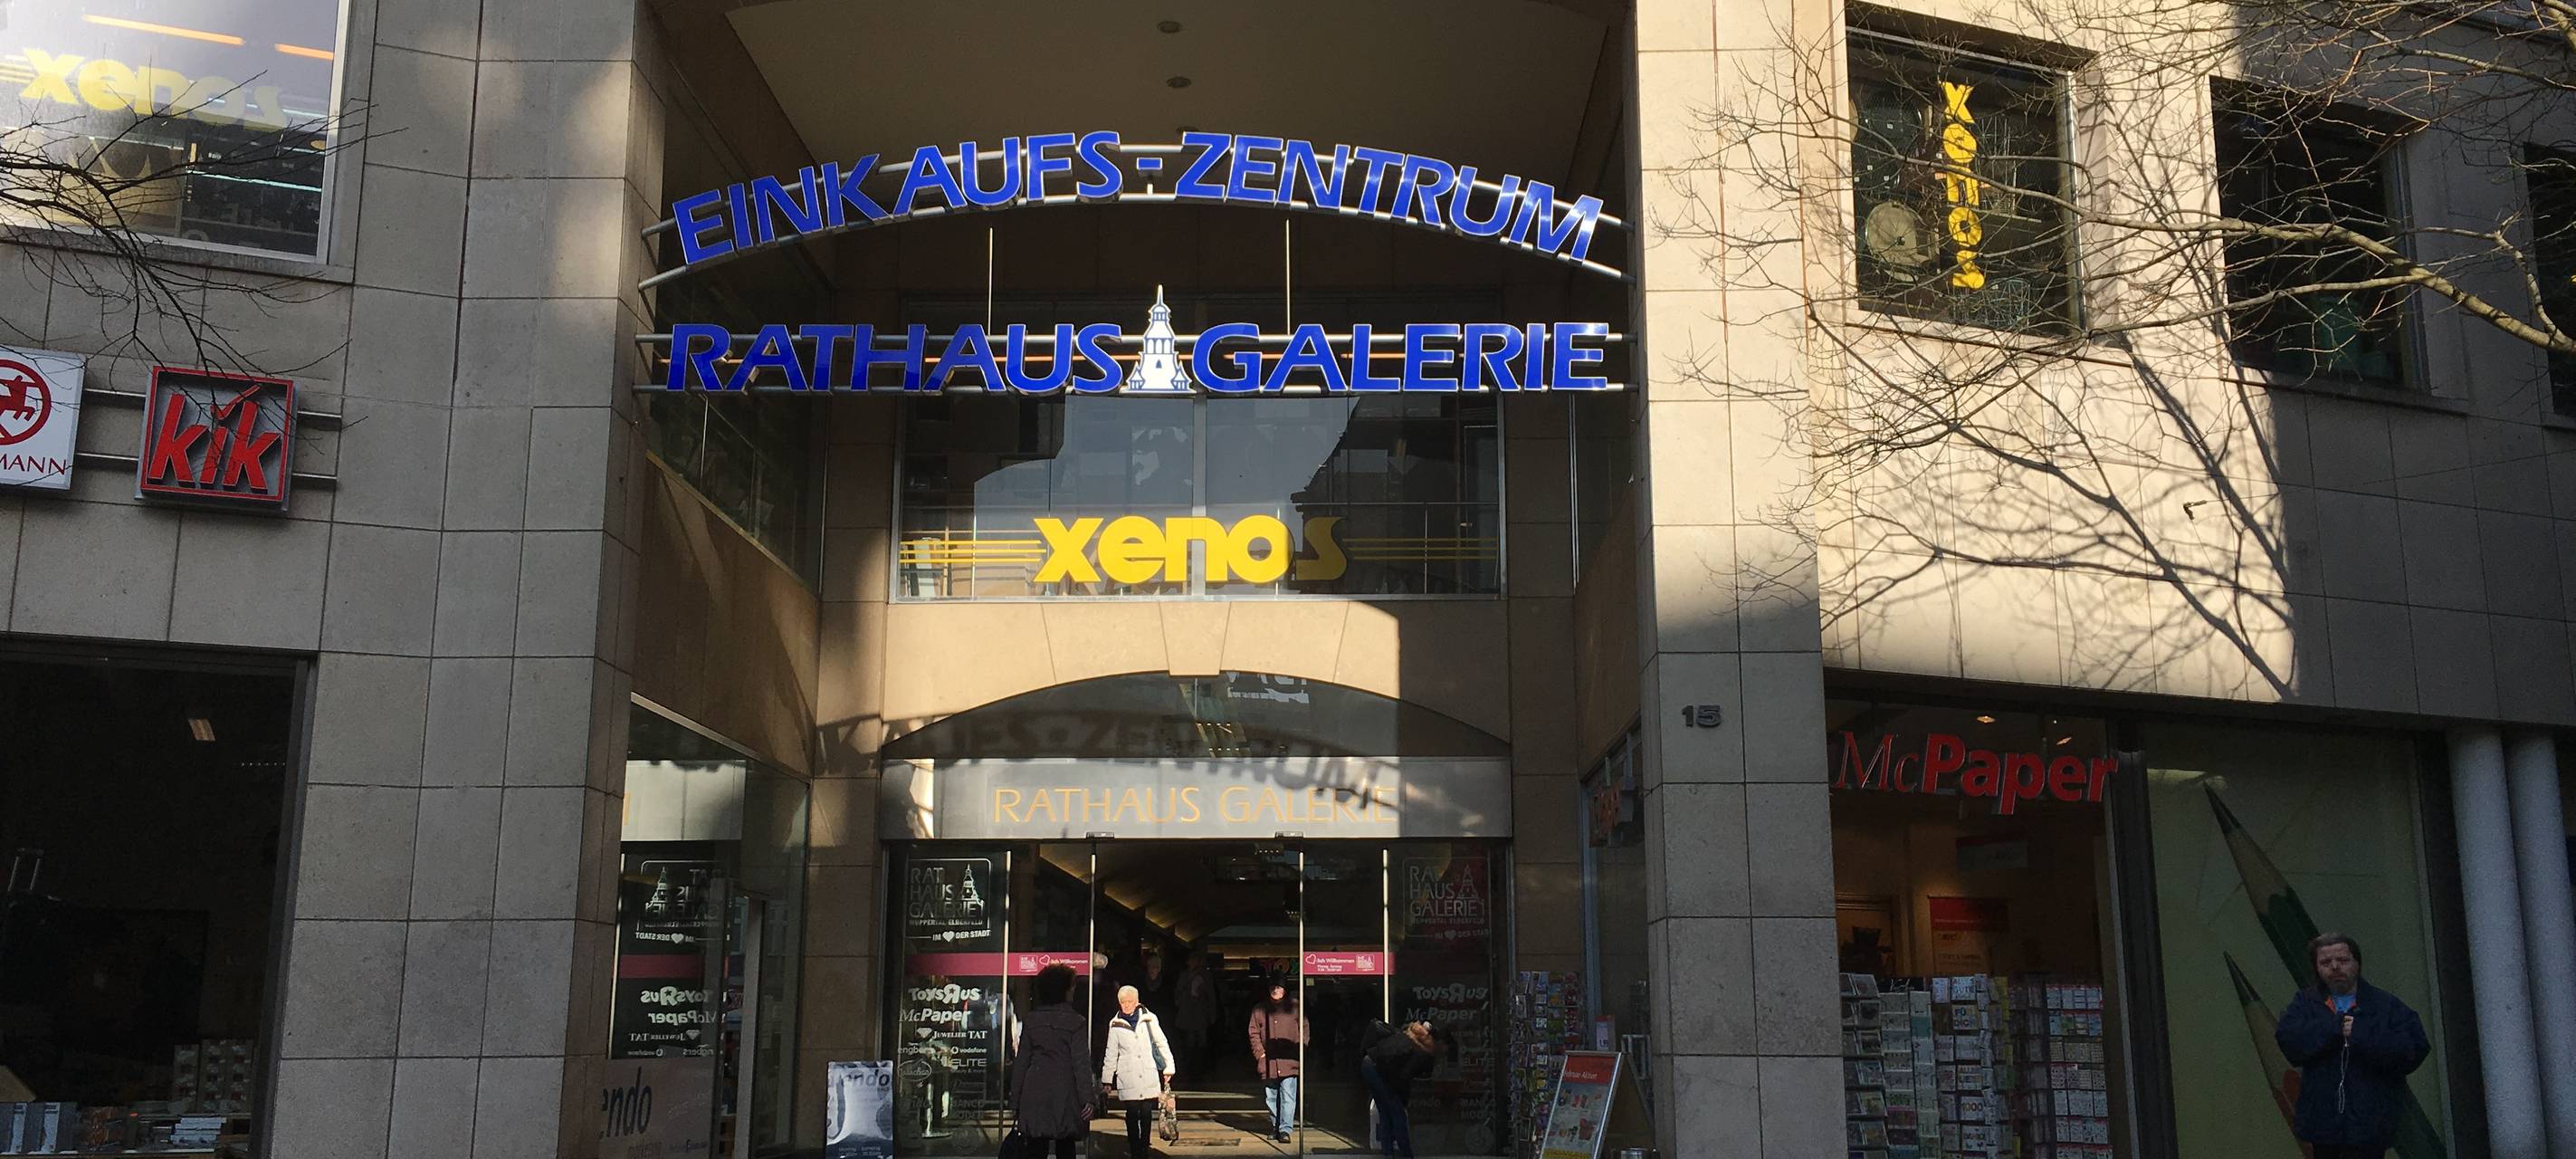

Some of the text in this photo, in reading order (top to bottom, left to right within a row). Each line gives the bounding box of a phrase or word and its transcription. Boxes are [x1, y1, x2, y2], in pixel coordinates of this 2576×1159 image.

[19, 47, 286, 133] xenos
[1939, 81, 1986, 291] xenos
[666, 322, 1609, 393] RATHAUS GALERIE
[1034, 514, 1348, 584] xenos
[1681, 705, 1722, 728] 15
[1834, 729, 2120, 815] McPaper
[993, 785, 1400, 824] RATHAUS GALERIE
[1410, 883, 1455, 899] HAUS
[1410, 900, 1478, 916] GALERIE
[970, 929, 991, 938] STADT
[899, 1008, 971, 1024] McPaper
